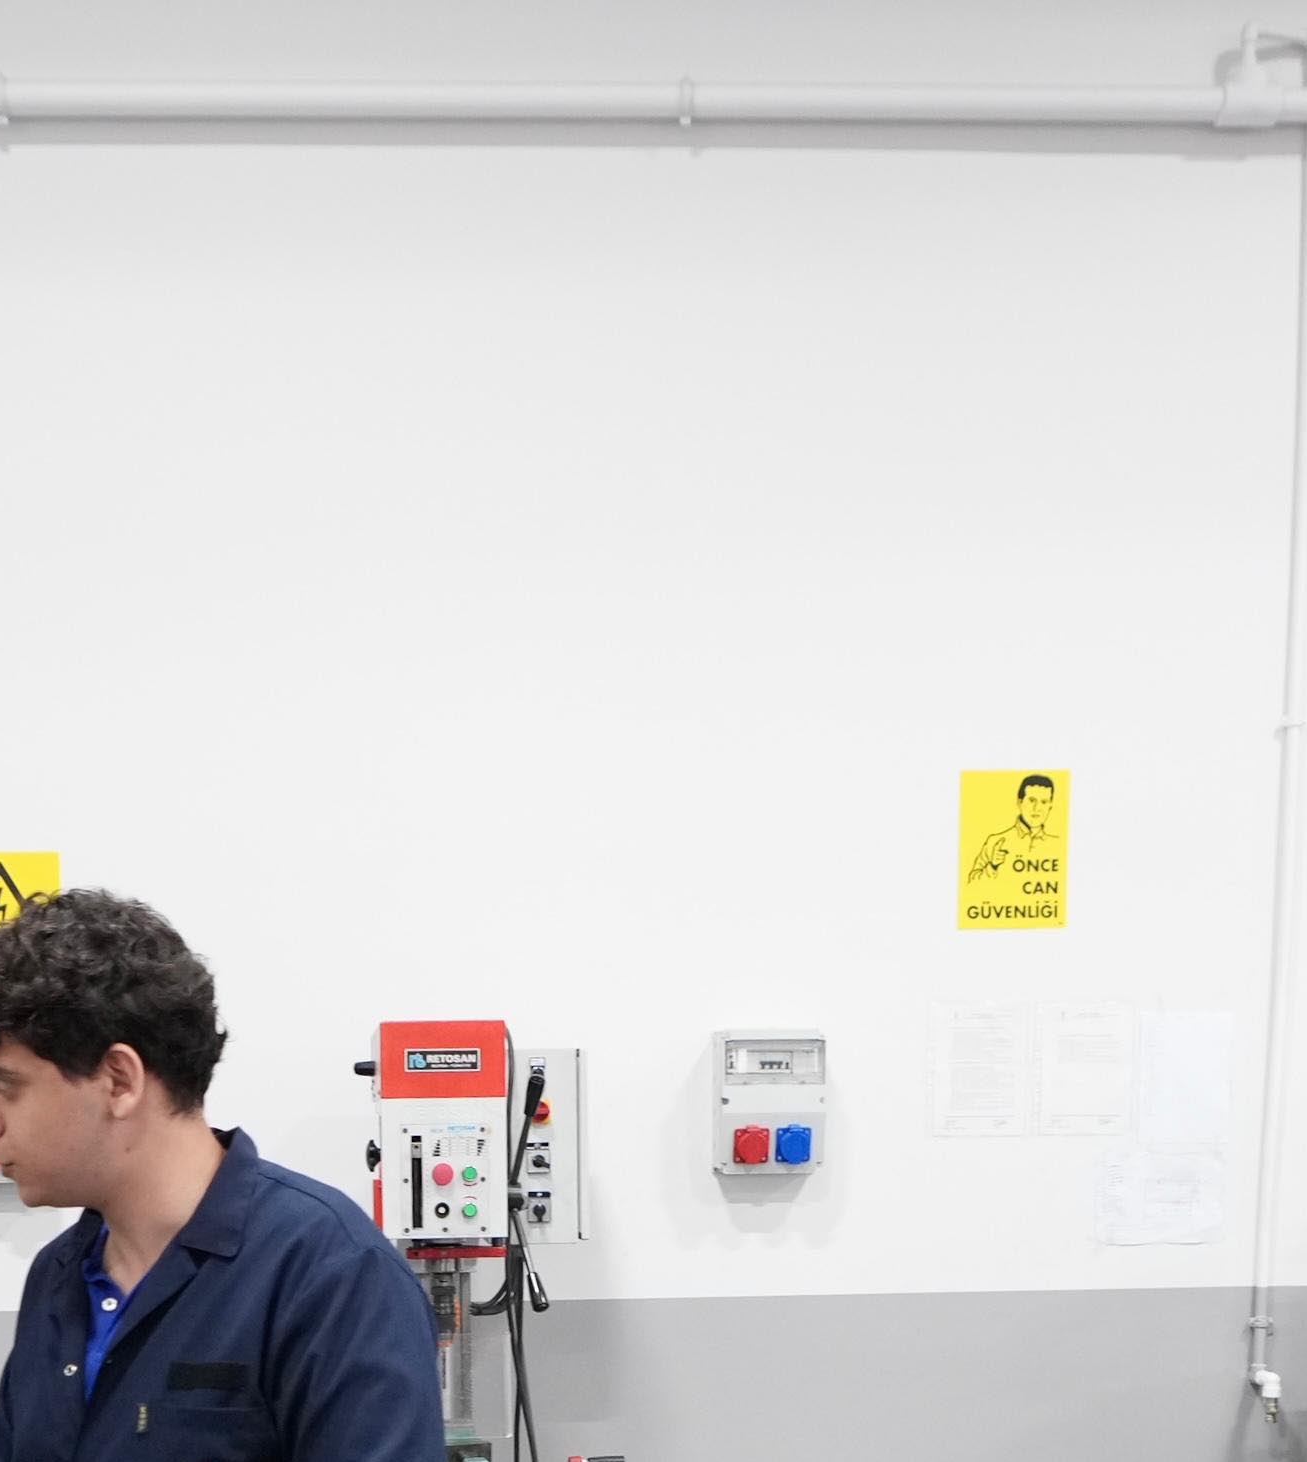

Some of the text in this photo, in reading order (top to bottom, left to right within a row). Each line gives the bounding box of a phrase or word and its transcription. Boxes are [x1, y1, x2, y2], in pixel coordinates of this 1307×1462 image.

[1012, 854, 1059, 873] ÖNCE
[1022, 881, 1059, 895] CAN
[967, 900, 1058, 919] GÜVENLİĞİ
[426, 1054, 477, 1063] RETOSAN
